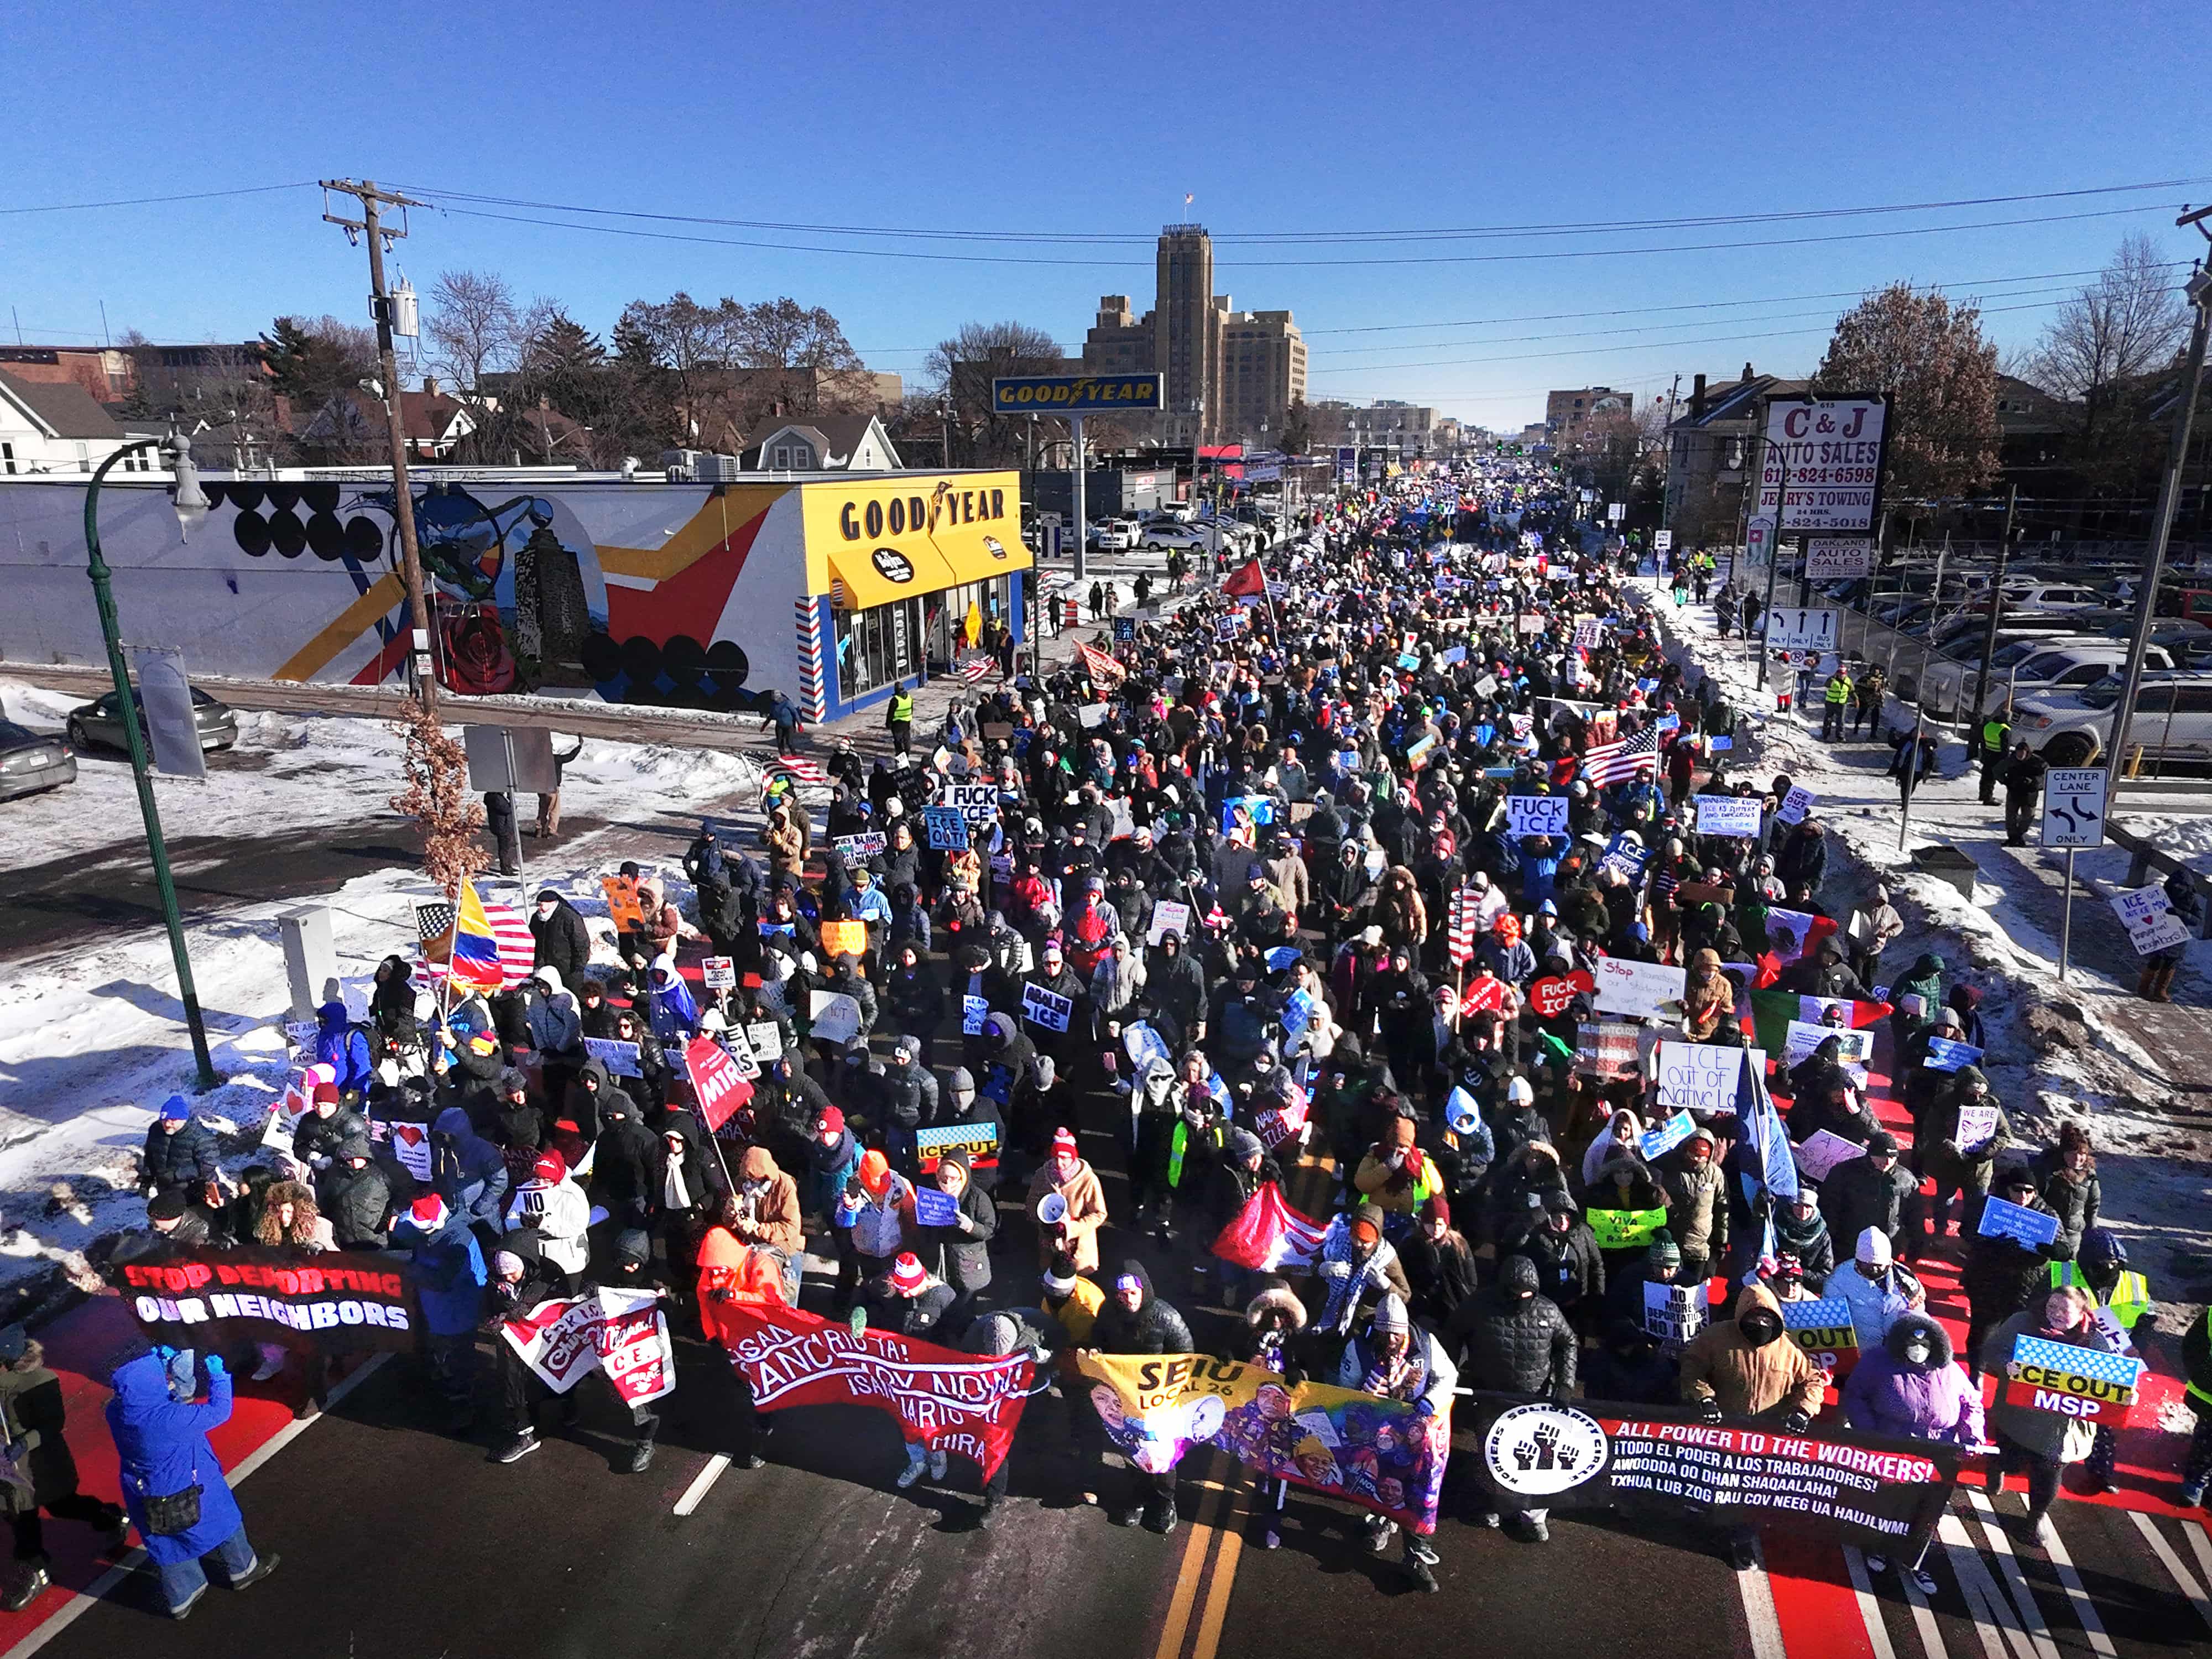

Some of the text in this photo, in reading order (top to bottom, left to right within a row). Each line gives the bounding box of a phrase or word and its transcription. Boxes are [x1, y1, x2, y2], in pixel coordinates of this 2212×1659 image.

[999, 383, 1154, 404] GOODYEAR
[1784, 408, 1867, 439] C & J
[1766, 442, 1877, 464] AUTO SALES
[1761, 492, 1871, 506] JERY'S TOWING
[839, 489, 1004, 541] GOODYEAR
[2053, 773, 2099, 781] CENTER
[2059, 782, 2091, 791] LANE
[953, 787, 997, 805] FUCK
[1786, 797, 1807, 810] OUT
[1791, 791, 1808, 801] ICE
[1511, 799, 1564, 817] FUCK
[930, 816, 958, 831] ICE
[853, 834, 882, 844] BLAME
[933, 832, 964, 845] OUT!
[2056, 834, 2088, 843] ONLY
[2122, 893, 2145, 909] ICE
[1604, 961, 1634, 980] Stop
[1542, 980, 1578, 998] FUCK
[1034, 1005, 1061, 1030] ICE
[1682, 1046, 1730, 1070] ICE
[1668, 1066, 1698, 1086] Out
[1661, 1085, 1713, 1107] Native
[1979, 1110, 1995, 1119] ARE
[920, 1140, 995, 1158] ICE OUT
[523, 1192, 545, 1213] NO
[1610, 1217, 1638, 1226] VIVA
[125, 1264, 402, 1298] STOP DEPORTING
[1671, 1289, 1686, 1303] NO
[136, 1294, 409, 1331] OUR NEIGHBORS
[1666, 1301, 1692, 1314] MORE
[1647, 1318, 1668, 1336] NO
[1798, 1328, 1853, 1349] OUT
[932, 1364, 1022, 1401] NOW!
[1138, 1358, 1245, 1391] SEIU
[1140, 1381, 1233, 1410] LOCAL 26
[2066, 1375, 2132, 1402] OUT
[2034, 1390, 2101, 1418] MSP
[1507, 1406, 1602, 1482] SOLIDARITY CIRCLE
[1616, 1422, 1934, 1483] ALL POWER TO THE WORKERS!
[1490, 1427, 1519, 1484] WORKERS
[1614, 1441, 1879, 1493] ¡TODO EL PODER A LOS TRABAJADORES!
[1611, 1458, 1838, 1499] AWOODDA OO DHAN SHAQAALAHA!
[1610, 1475, 1910, 1537] TXHUA LUB ZOG RAU COV NEEG UA HAUJLWM!
